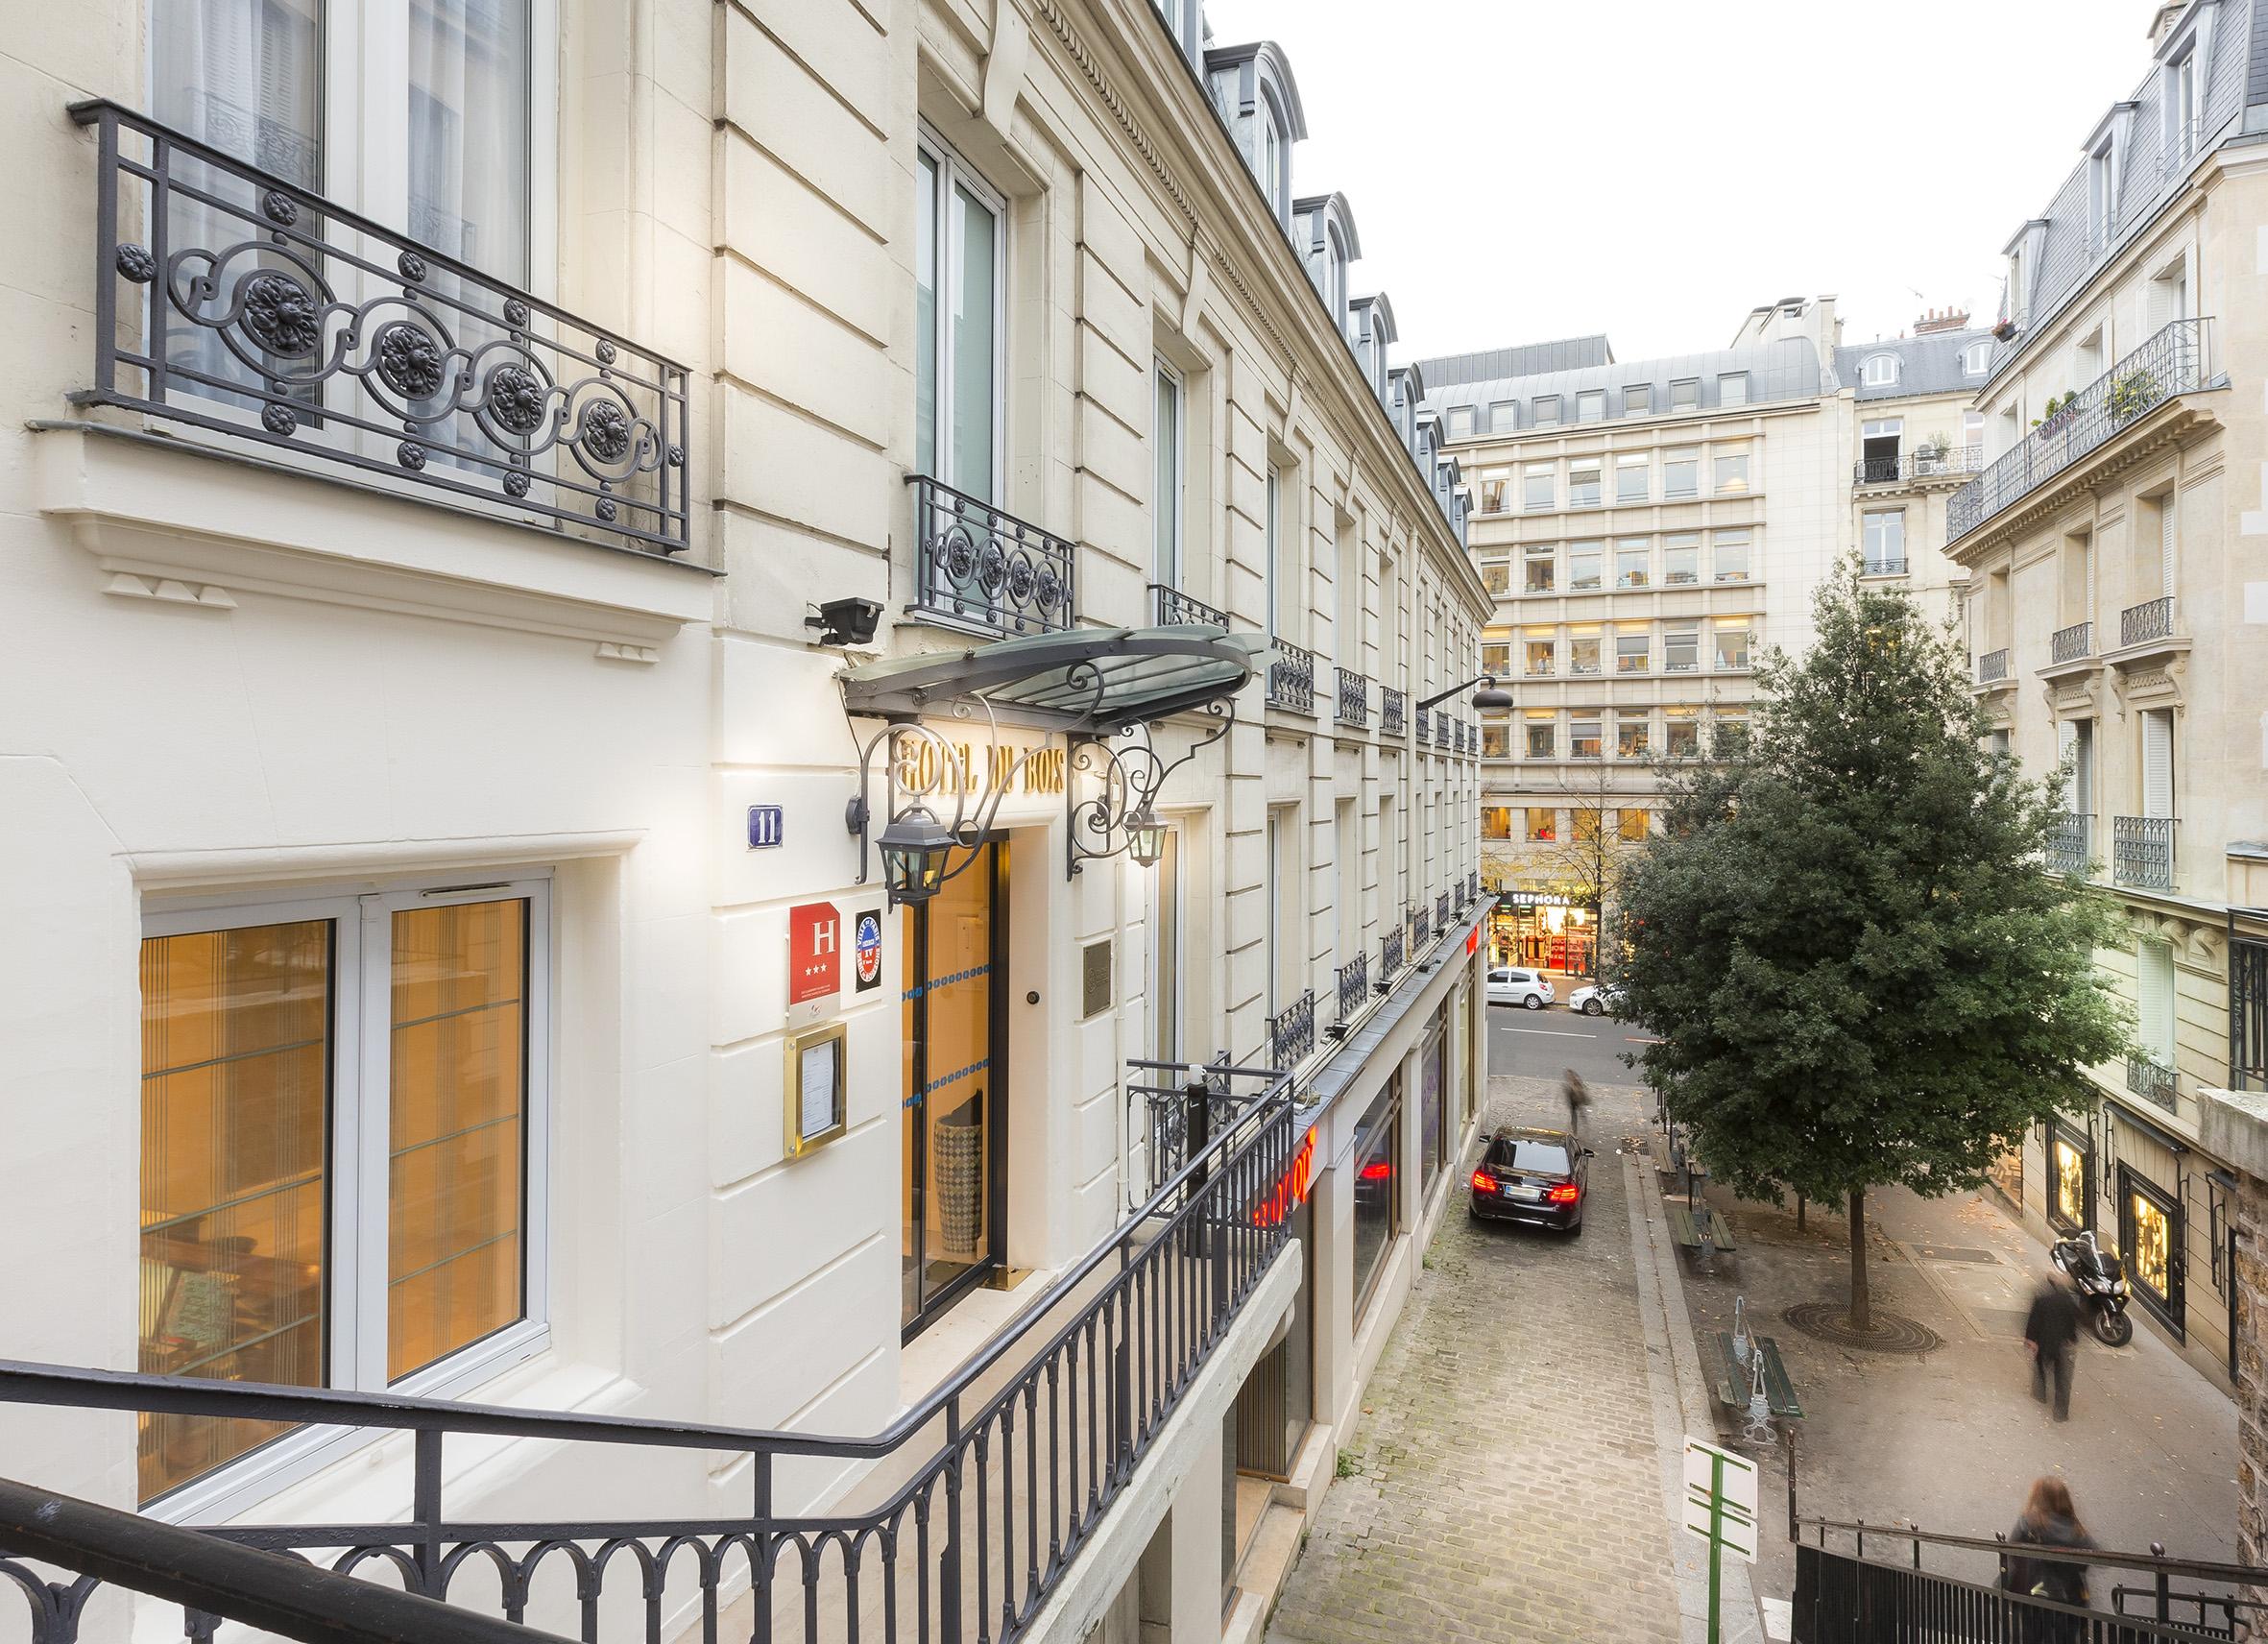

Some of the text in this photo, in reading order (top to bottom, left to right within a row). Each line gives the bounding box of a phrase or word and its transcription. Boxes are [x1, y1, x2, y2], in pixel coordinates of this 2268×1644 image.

[987, 744, 1014, 794] DU
[1023, 746, 1065, 795] BOIS
[758, 810, 775, 843] 11
[1512, 893, 1570, 906] SEPHORA
[812, 919, 836, 956] H
